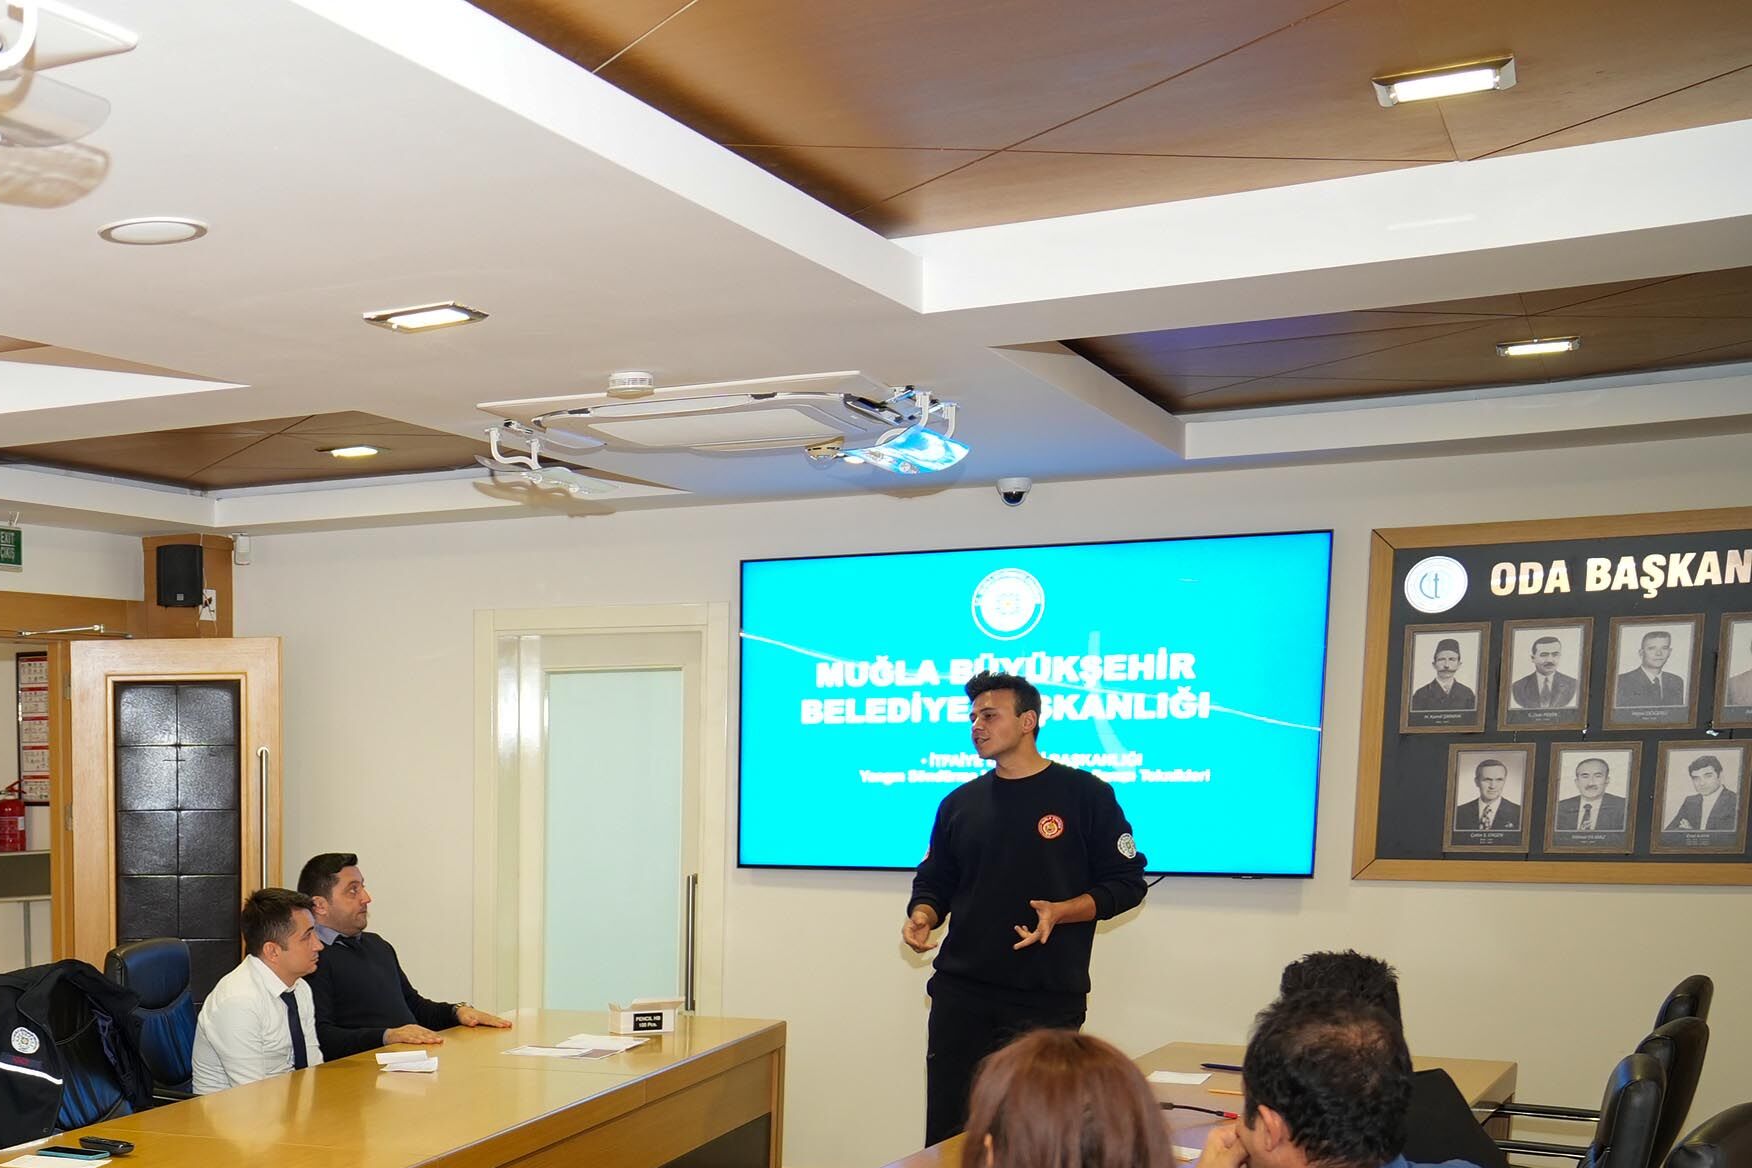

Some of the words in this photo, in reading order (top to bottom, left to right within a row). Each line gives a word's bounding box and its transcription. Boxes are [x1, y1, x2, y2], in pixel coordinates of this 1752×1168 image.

[0, 531, 15, 544] EXIT
[1490, 559, 1571, 596] ODA
[1585, 549, 1752, 599] BAŞKAN
[815, 655, 940, 688] MUĞLA
[949, 647, 1197, 689] BÜYÜKŞEHİR
[800, 691, 971, 725] BELEDİYE
[1039, 685, 1211, 728] ŞKANLIĞI
